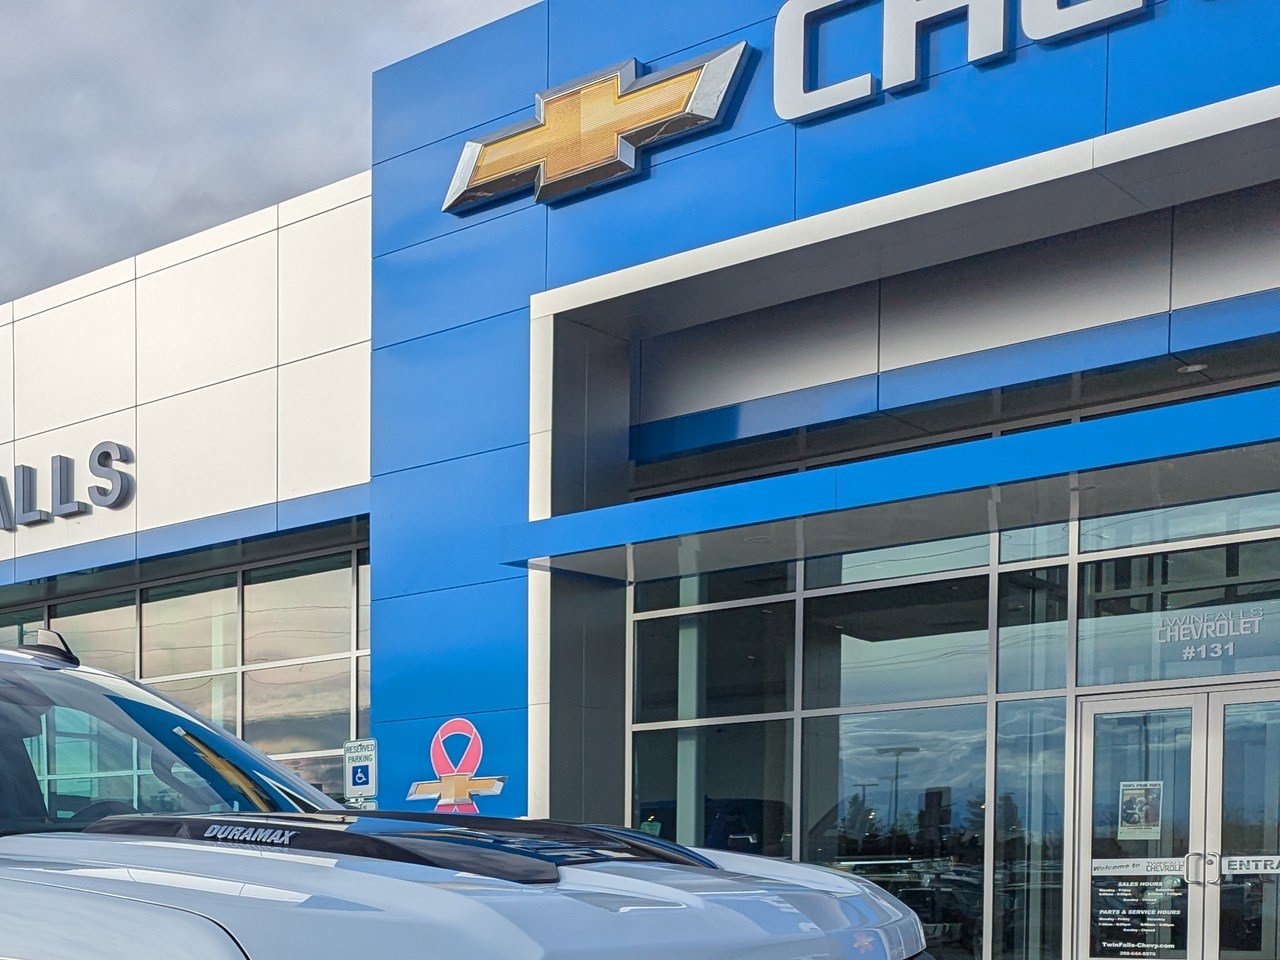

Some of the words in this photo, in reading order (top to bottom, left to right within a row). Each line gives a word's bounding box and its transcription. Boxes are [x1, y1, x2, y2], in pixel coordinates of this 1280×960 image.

[1156, 616, 1263, 643] CHEVROLET
[1182, 642, 1235, 660] #131
[346, 743, 375, 753] RESERVED
[348, 754, 373, 764] PARKING
[203, 824, 299, 845] DURAMAX
[1093, 862, 1130, 872] Welcome
